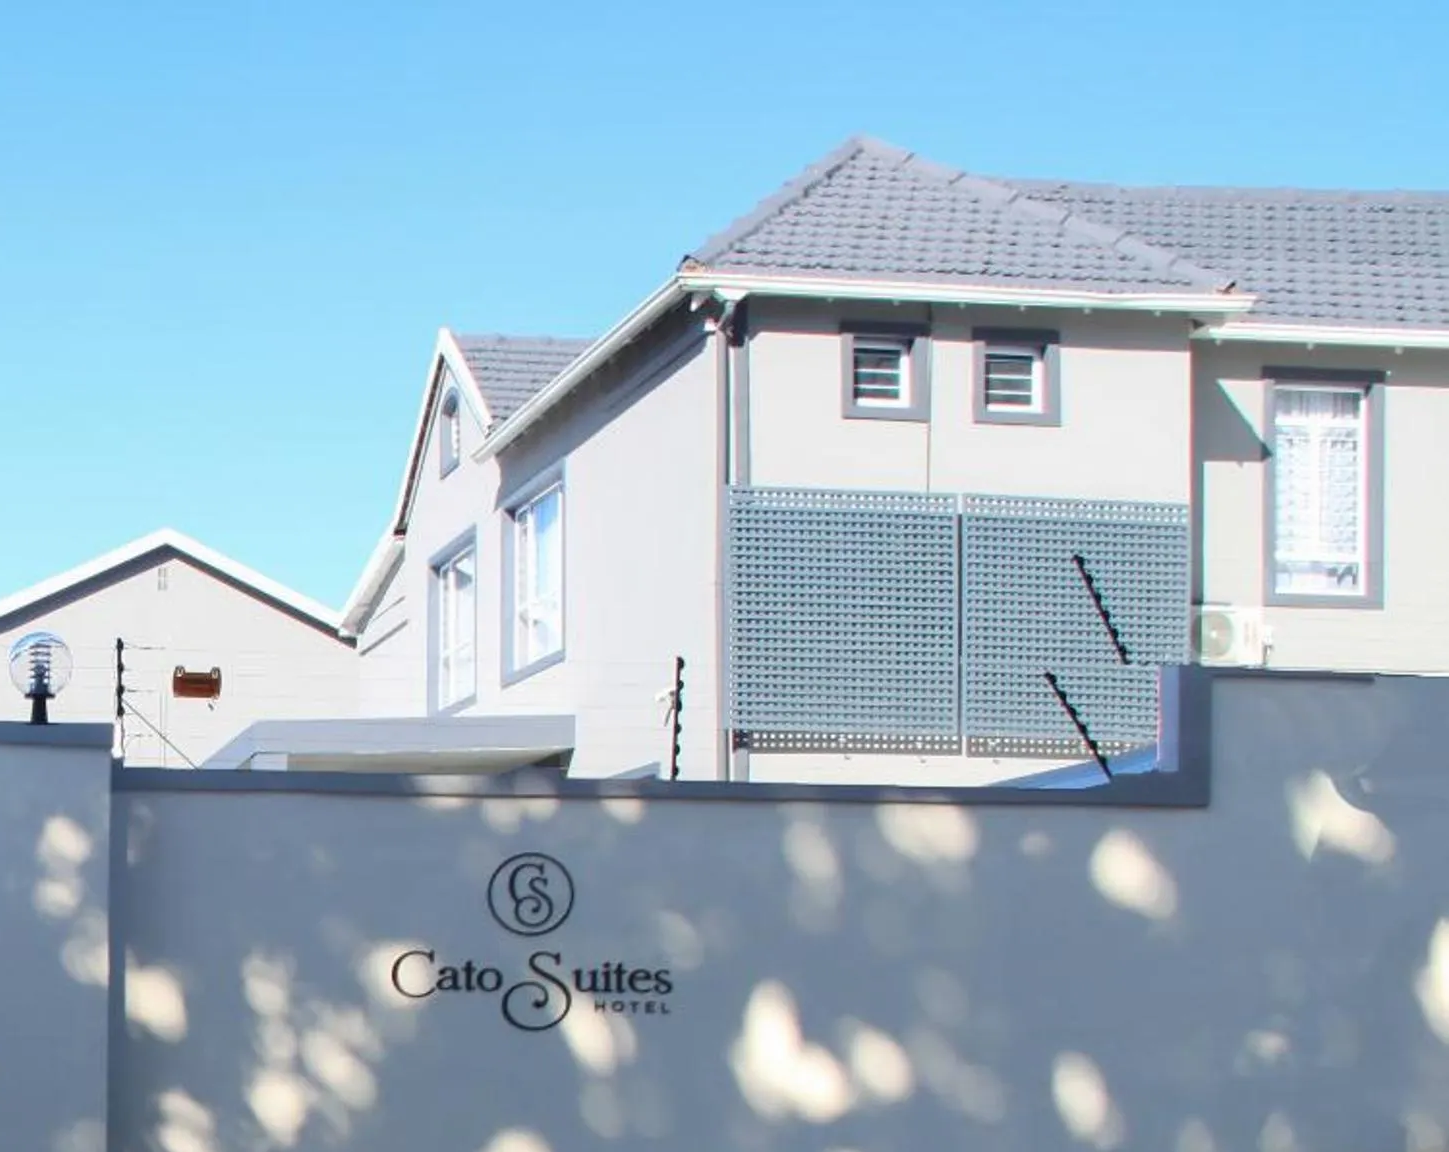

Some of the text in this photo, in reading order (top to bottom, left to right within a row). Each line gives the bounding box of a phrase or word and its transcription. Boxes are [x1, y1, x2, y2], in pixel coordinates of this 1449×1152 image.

[391, 949, 673, 1031] Cato Suites
[593, 1000, 672, 1015] HOTEL
